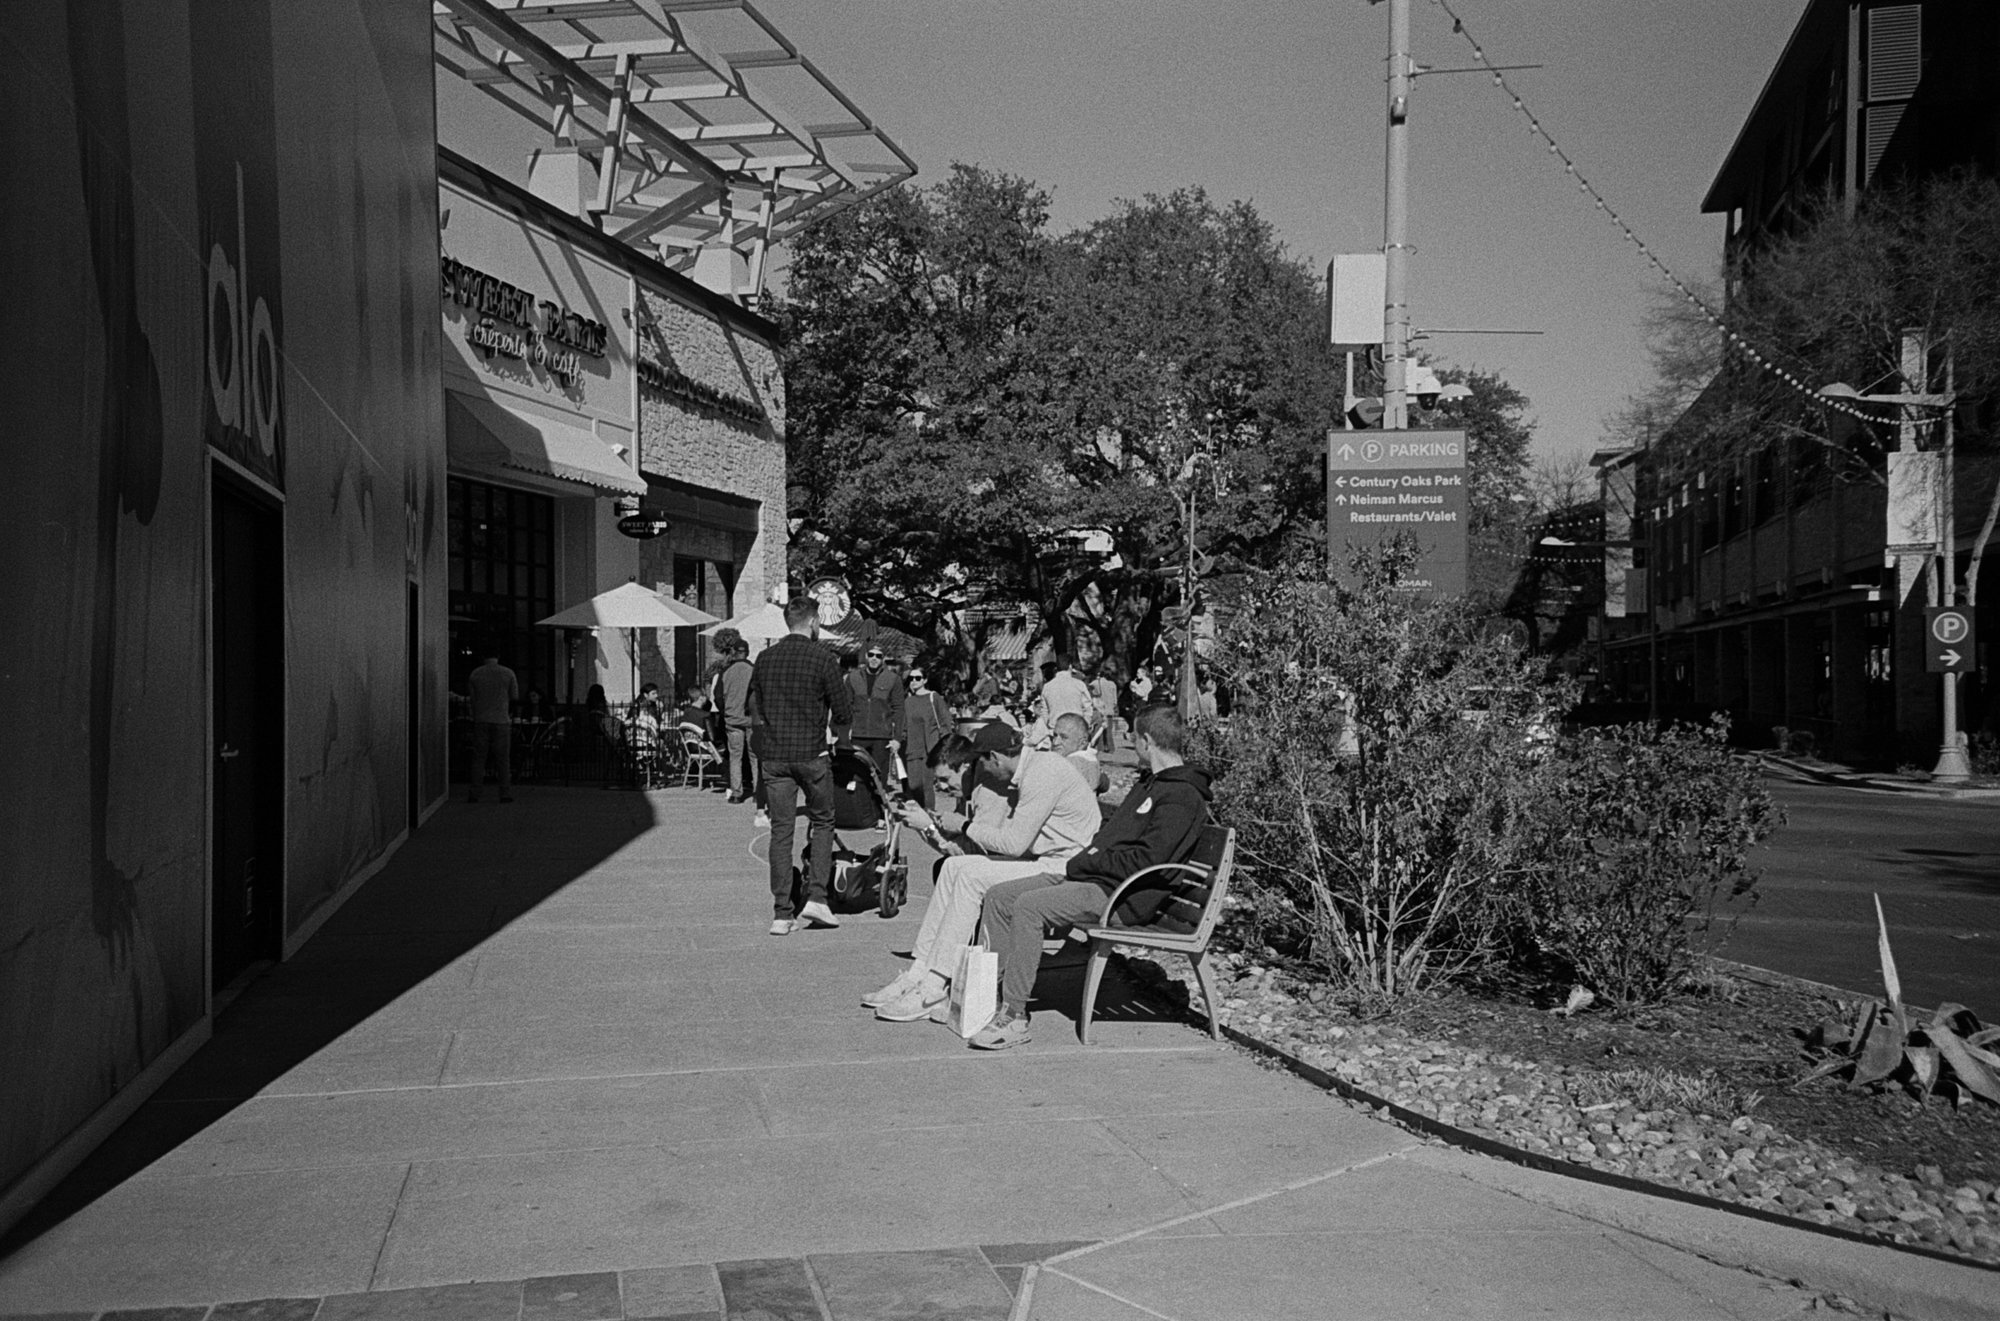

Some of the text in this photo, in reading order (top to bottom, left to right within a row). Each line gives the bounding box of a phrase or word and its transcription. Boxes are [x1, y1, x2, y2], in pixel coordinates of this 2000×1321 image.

[1389, 442, 1459, 457] PARKING
[1349, 475, 1462, 489] Century Oaks Park
[1349, 493, 1443, 505] Neiman Marcus
[1350, 510, 1457, 523] Restaurants/Valet
[1396, 579, 1433, 588] OMAIN
[1943, 617, 1960, 638] P
